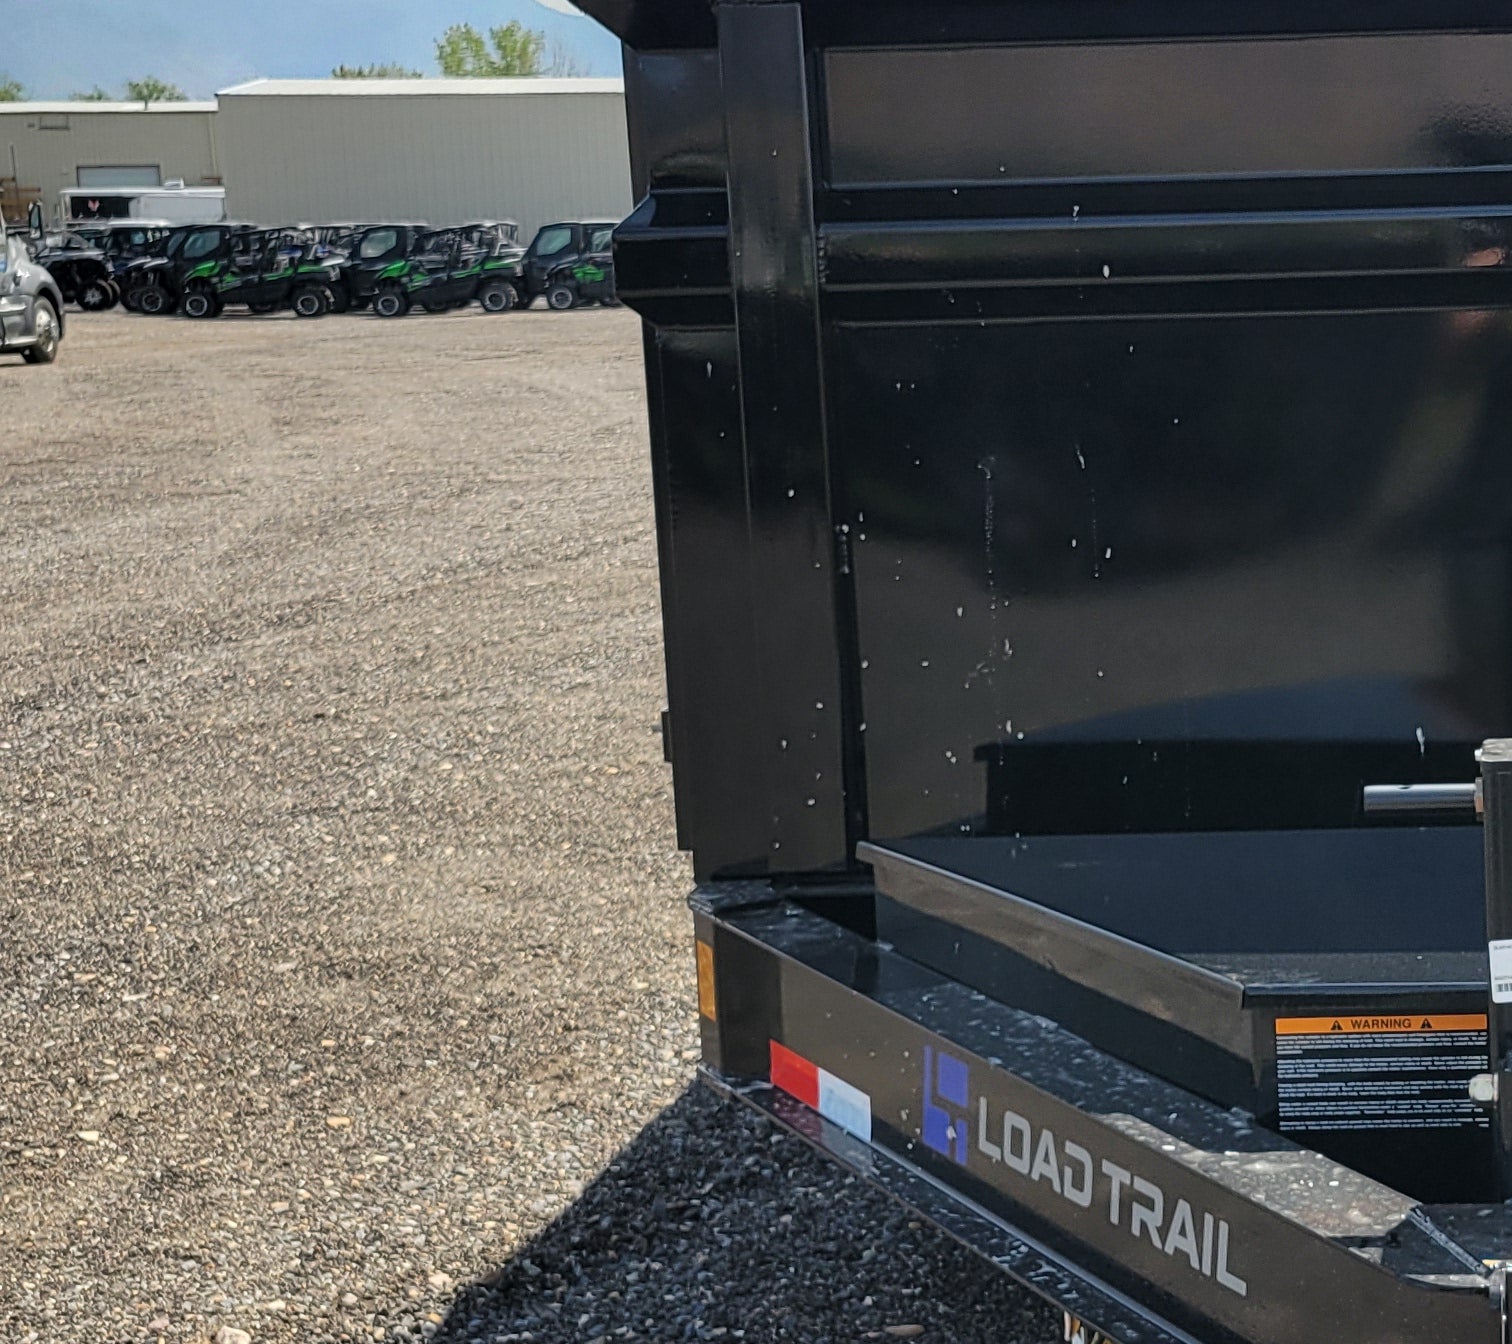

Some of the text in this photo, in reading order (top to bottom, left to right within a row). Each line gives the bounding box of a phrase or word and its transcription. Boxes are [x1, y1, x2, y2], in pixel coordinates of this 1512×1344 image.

[1350, 1018, 1412, 1029] WARNING
[978, 1096, 1247, 1297] LOAD TRAIL
